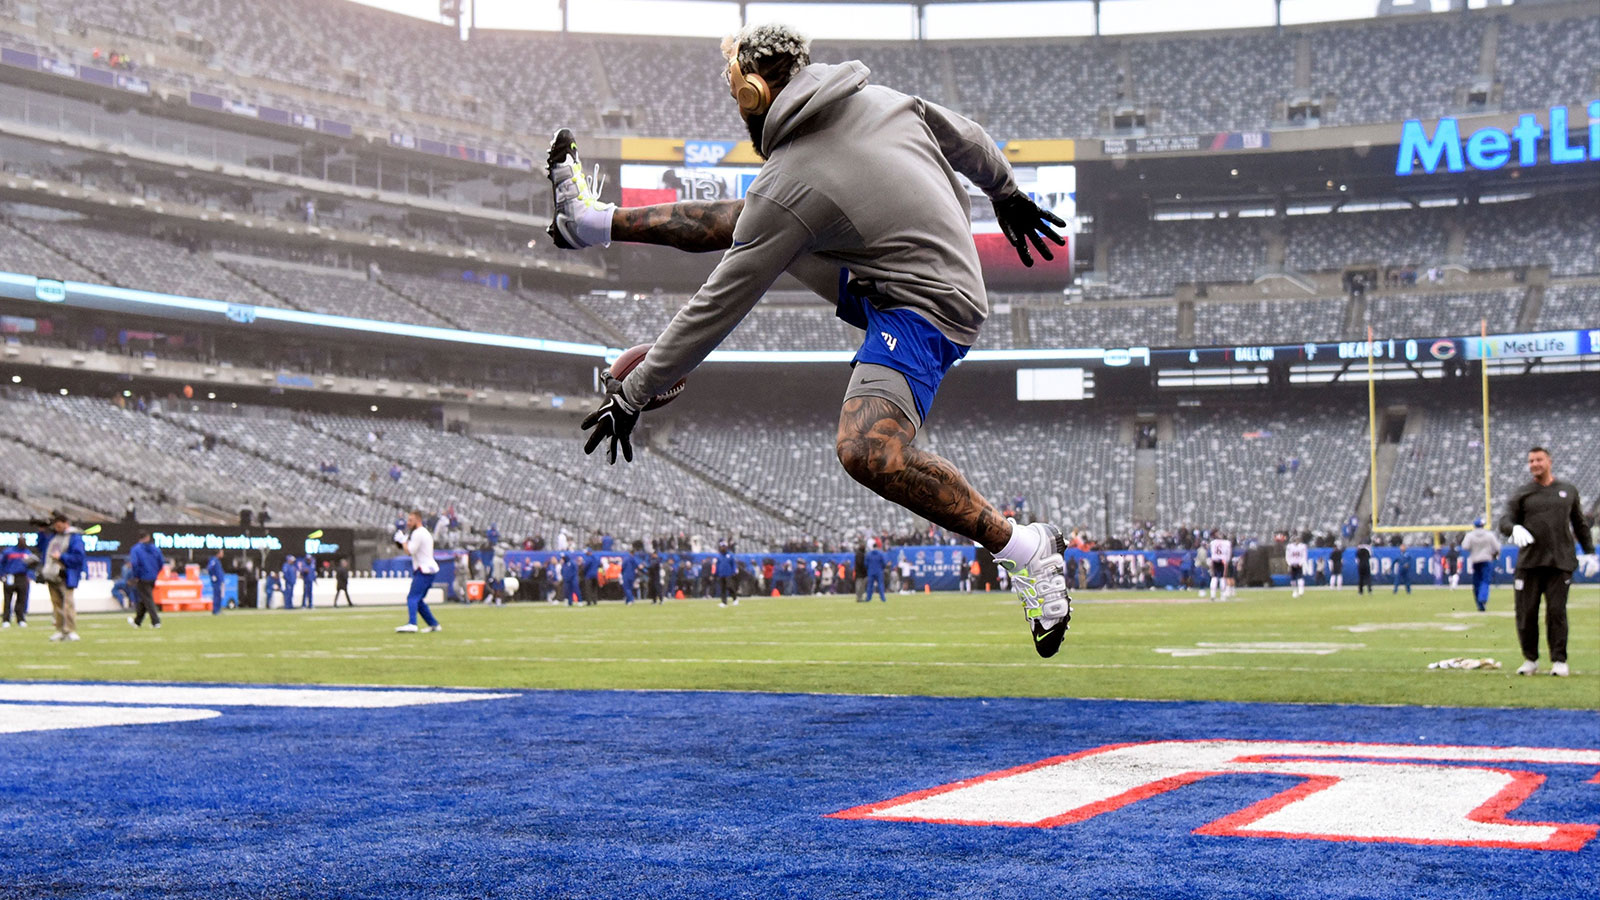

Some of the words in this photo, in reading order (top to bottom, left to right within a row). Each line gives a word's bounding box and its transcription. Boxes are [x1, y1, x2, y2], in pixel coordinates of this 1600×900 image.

[685, 144, 726, 164] SAP
[1234, 347, 1259, 361] BALL
[1259, 346, 1275, 360] ON
[1339, 341, 1383, 358] BEARS
[1405, 339, 1418, 360] 0
[1503, 338, 1565, 354] MetLife
[153, 532, 173, 548] The
[174, 533, 205, 549] better
[205, 533, 223, 549] the
[305, 539, 320, 554] EY
